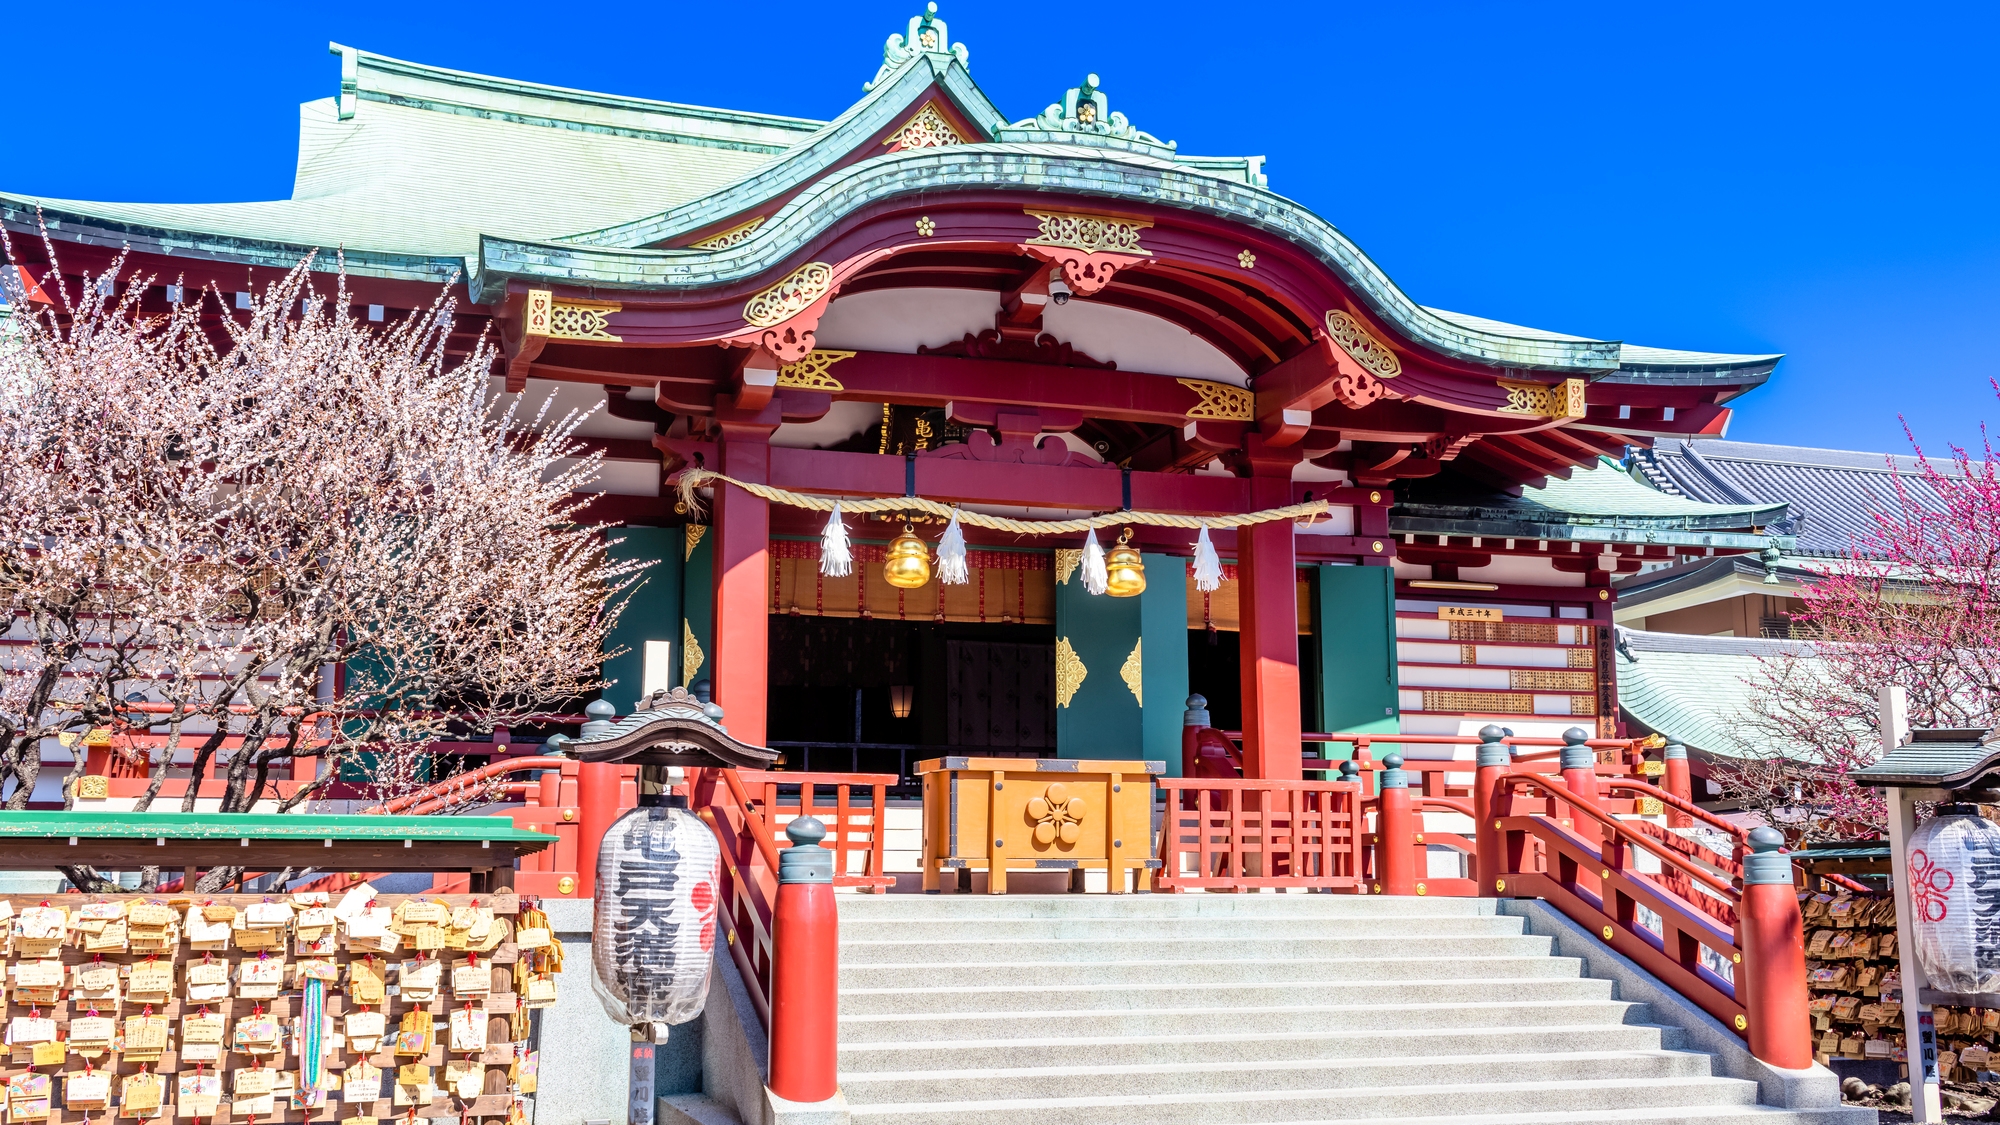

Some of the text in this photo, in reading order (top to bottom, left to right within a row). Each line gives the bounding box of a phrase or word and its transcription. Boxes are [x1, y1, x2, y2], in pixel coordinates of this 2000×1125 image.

[1448, 607, 1492, 618] 平成三十年
[1599, 628, 1613, 763] 藤の花育成基金奉賛者御名
